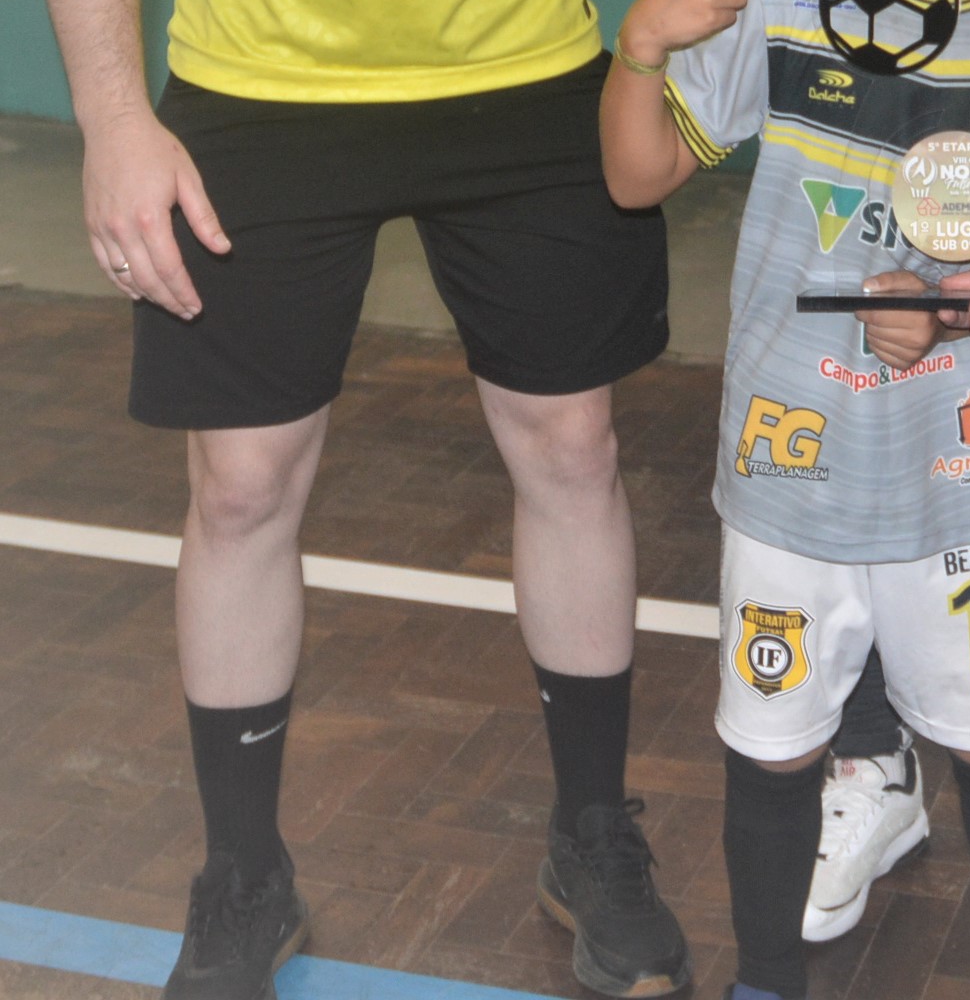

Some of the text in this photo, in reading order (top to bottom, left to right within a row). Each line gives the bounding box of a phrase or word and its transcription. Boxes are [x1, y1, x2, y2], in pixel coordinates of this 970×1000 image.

[932, 239, 958, 251] SUB
[736, 394, 827, 470] FG
[747, 461, 829, 481] TERRAPLANAGEM
[744, 609, 802, 629] INTERATIVO
[756, 646, 782, 669] IF
